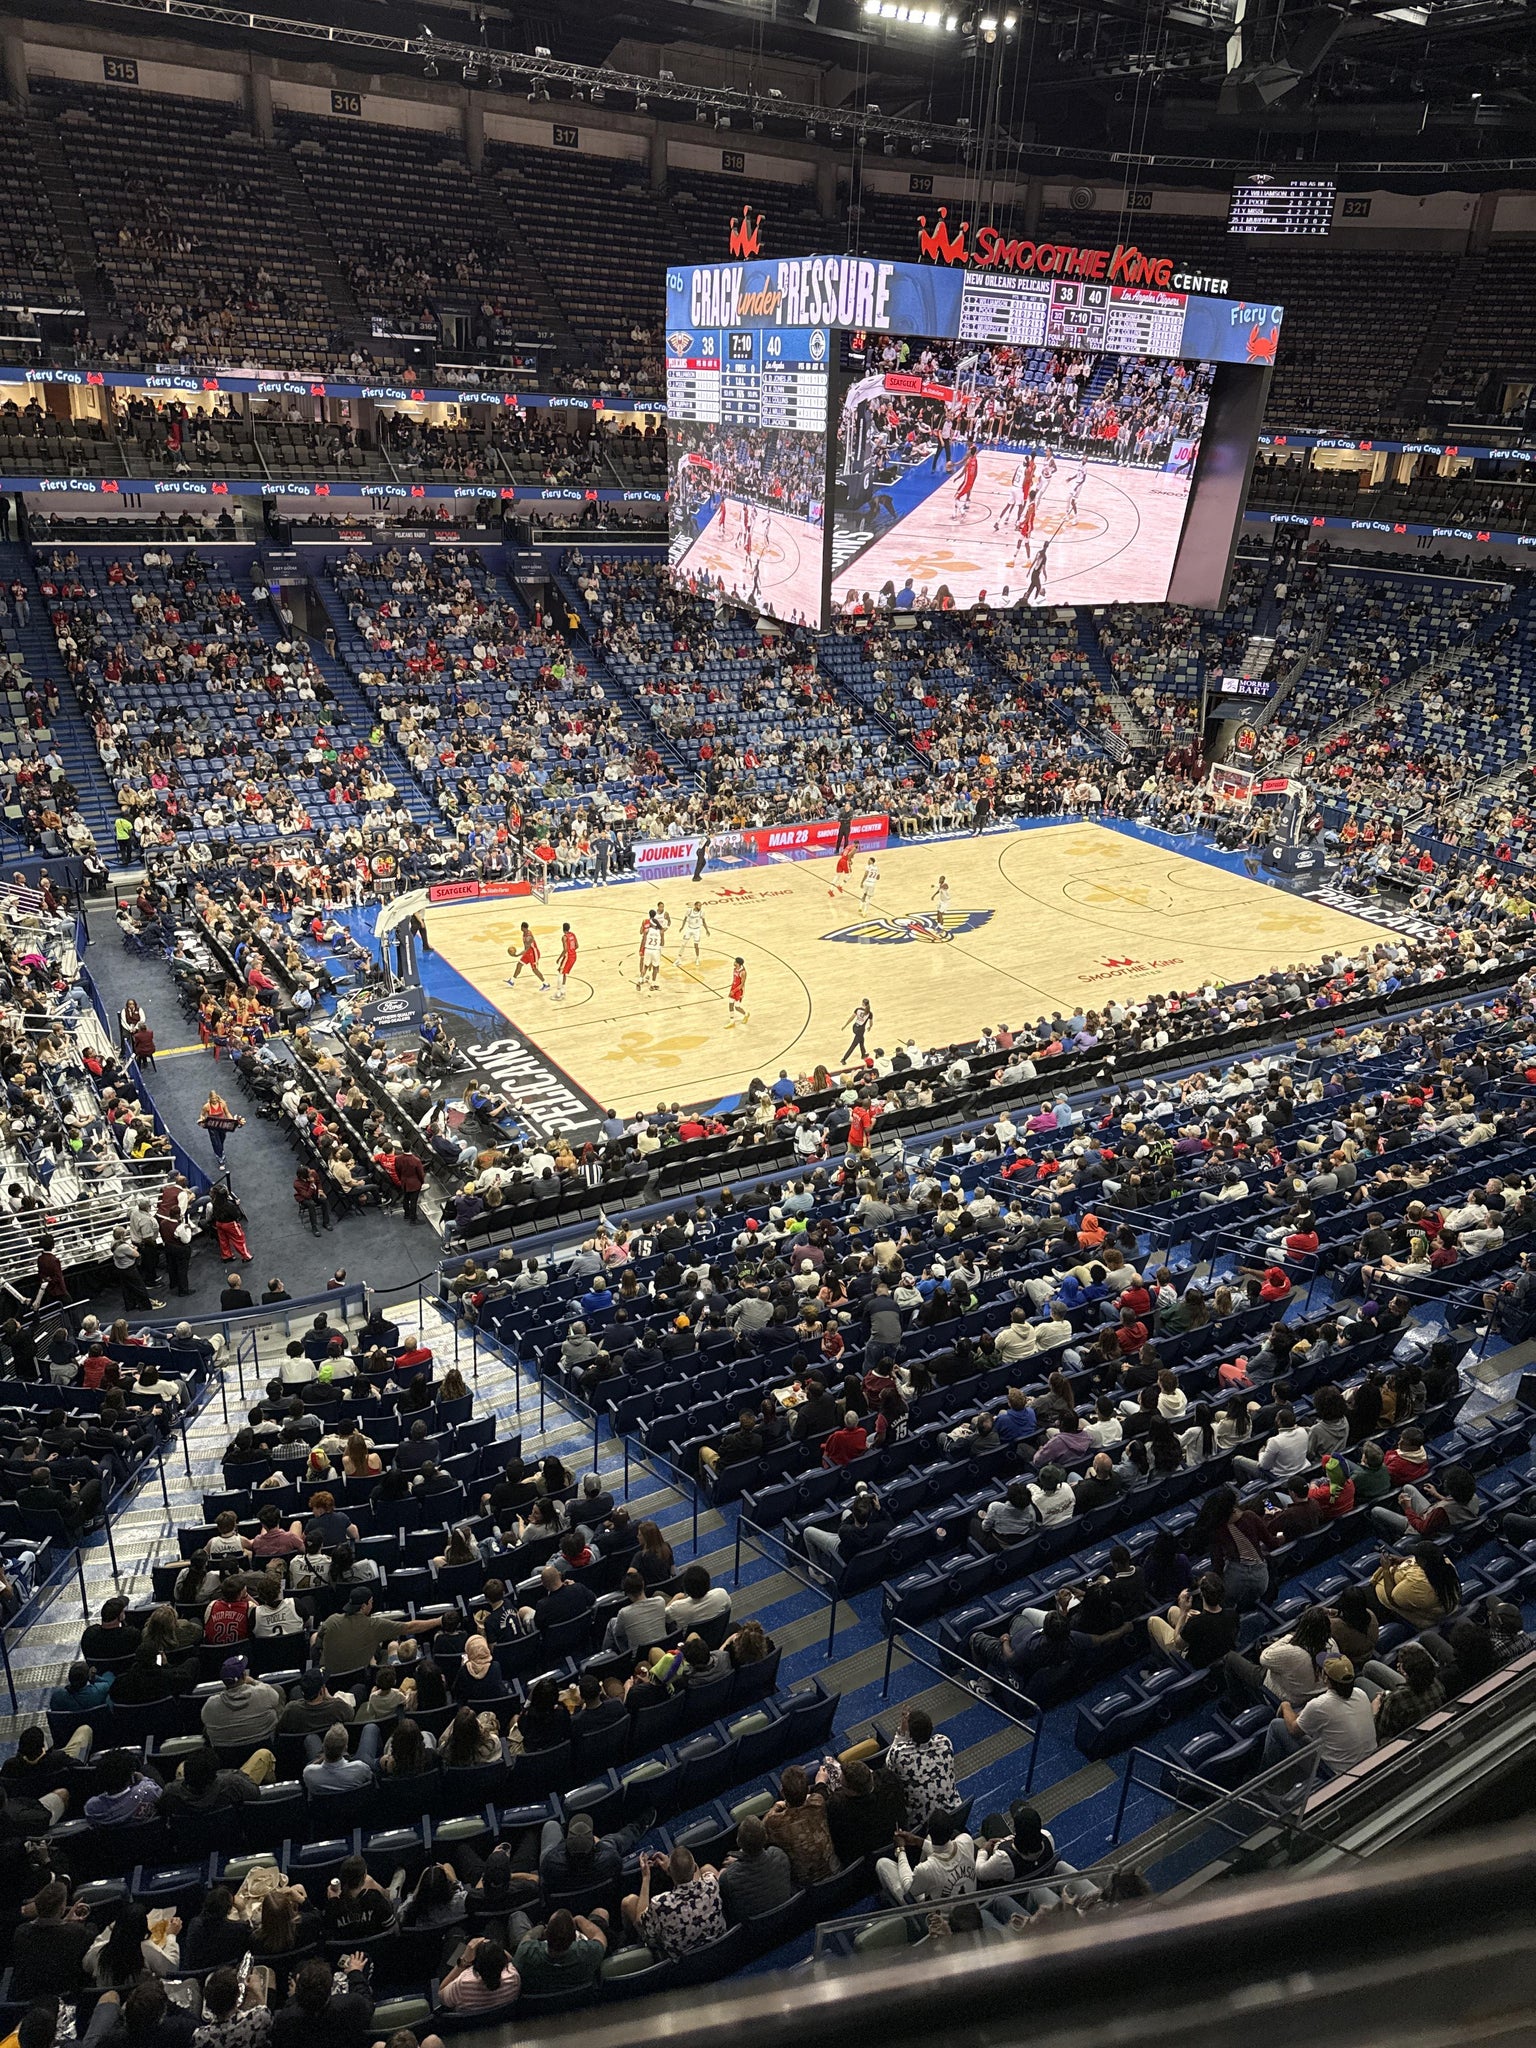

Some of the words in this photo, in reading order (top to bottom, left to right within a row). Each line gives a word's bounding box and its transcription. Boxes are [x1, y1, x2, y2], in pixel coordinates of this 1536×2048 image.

[107, 60, 136, 80] 315
[333, 95, 360, 112] 316
[554, 128, 576, 144] 317
[723, 154, 744, 169] 318
[911, 178, 932, 191] 319
[1127, 193, 1151, 207] 320
[1345, 201, 1368, 215] 321
[972, 227, 1109, 279] SMOOTHIE
[666, 274, 683, 292] rab
[966, 273, 984, 285] NEW
[984, 275, 1016, 290] ORLEANS
[1017, 278, 1050, 293] PELICANS
[1173, 274, 1230, 295] CENTER
[7, 291, 22, 299] 314
[691, 267, 744, 327] CRACK
[737, 275, 782, 317] under
[775, 258, 894, 329] PRESSURE
[1060, 287, 1073, 301] 38
[1088, 290, 1102, 304] 40
[1132, 290, 1156, 305] Angeles
[1156, 292, 1179, 307] Clippers
[1070, 312, 1088, 323] 7:10
[1231, 303, 1267, 327] Fiery
[702, 337, 714, 356] 38
[732, 335, 751, 351] 7:10
[767, 336, 781, 356] 40
[726, 364, 730, 373] 2
[751, 365, 755, 374] 0
[25, 370, 53, 382] Fiery
[56, 370, 81, 384] Crab
[146, 376, 171, 388] Fiery
[174, 377, 198, 390] Crab
[726, 376, 730, 386] 5
[751, 377, 755, 386] 6
[258, 382, 282, 393] Fiery
[284, 382, 306, 396] Crab
[361, 387, 384, 399] Fiery
[385, 388, 407, 400] Crab
[458, 392, 479, 403] Fiery
[481, 393, 500, 404] Crab
[549, 397, 569, 408] Fiery
[570, 397, 588, 409] Crab
[634, 401, 652, 412] Fiery
[1258, 436, 1270, 445] rab
[1317, 438, 1336, 448] Fiery
[1337, 440, 1355, 449] Crab
[1402, 444, 1421, 453] Fiery
[1423, 445, 1441, 455] Crab
[1489, 449, 1509, 459] Fiery
[1512, 450, 1531, 461] Crab
[40, 479, 67, 492] Fiery
[70, 479, 96, 493] Crab
[154, 481, 180, 493] Fiery
[182, 481, 207, 494] Crab
[261, 483, 285, 495] Fiery
[287, 483, 310, 495] Crab
[361, 485, 384, 497] Fiery
[385, 485, 407, 497] Crab
[454, 486, 475, 498] Fiery
[477, 487, 497, 498] Crab
[121, 493, 142, 508] 111
[541, 488, 561, 500] Fiery
[563, 488, 582, 500] Crab
[623, 490, 642, 500] Fiery
[644, 490, 661, 501] Crab
[370, 496, 391, 511] 112
[598, 500, 610, 514] 13
[1270, 514, 1289, 523] Fiery
[1291, 515, 1308, 525] Crab
[1351, 520, 1371, 529] Fiery
[1372, 521, 1390, 532] Crab
[1433, 527, 1452, 537] Fiery
[1454, 529, 1473, 540] Crab
[1517, 536, 1536, 545] Fiery
[1416, 535, 1434, 549] 117
[1238, 686, 1269, 696] BART
[1240, 680, 1270, 688] MORRIS
[1239, 736, 1252, 751] 24
[817, 827, 839, 838] SMOOT
[850, 825, 861, 834] ING
[861, 823, 882, 833] CENTER
[769, 832, 793, 847] MAR
[794, 829, 809, 843] 28
[638, 844, 694, 863] JOURNEY
[1273, 847, 1283, 859] G
[437, 885, 473, 898] SEATGEEK
[1302, 888, 1440, 941] PELICANS
[648, 937, 657, 947] 23
[1078, 964, 1150, 983] SMOOTHIE
[1128, 969, 1163, 980] CENTER
[373, 1014, 397, 1022] SOUTHERN
[467, 1039, 601, 1137] PELICANS
[638, 1239, 653, 1257] 15
[896, 1421, 907, 1441] 15
[265, 1612, 287, 1625] POOLE
[214, 1621, 239, 1645] 25
